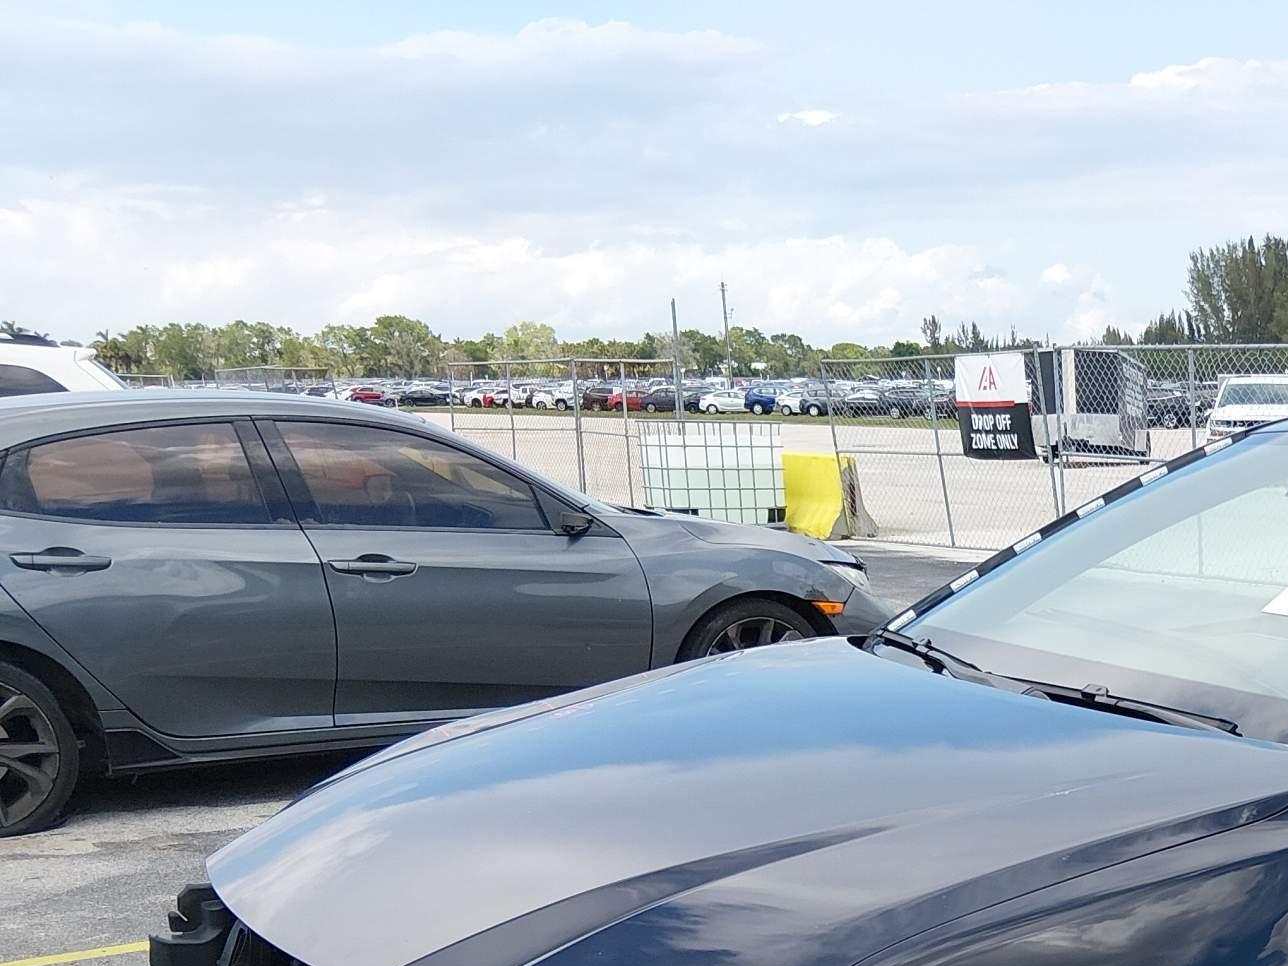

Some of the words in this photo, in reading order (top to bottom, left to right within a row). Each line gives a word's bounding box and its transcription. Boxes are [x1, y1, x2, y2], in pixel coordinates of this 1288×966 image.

[971, 414, 994, 431] DROP
[996, 413, 1012, 430] OFF
[970, 433, 997, 450] ZONE
[997, 433, 1019, 450] ONLY
